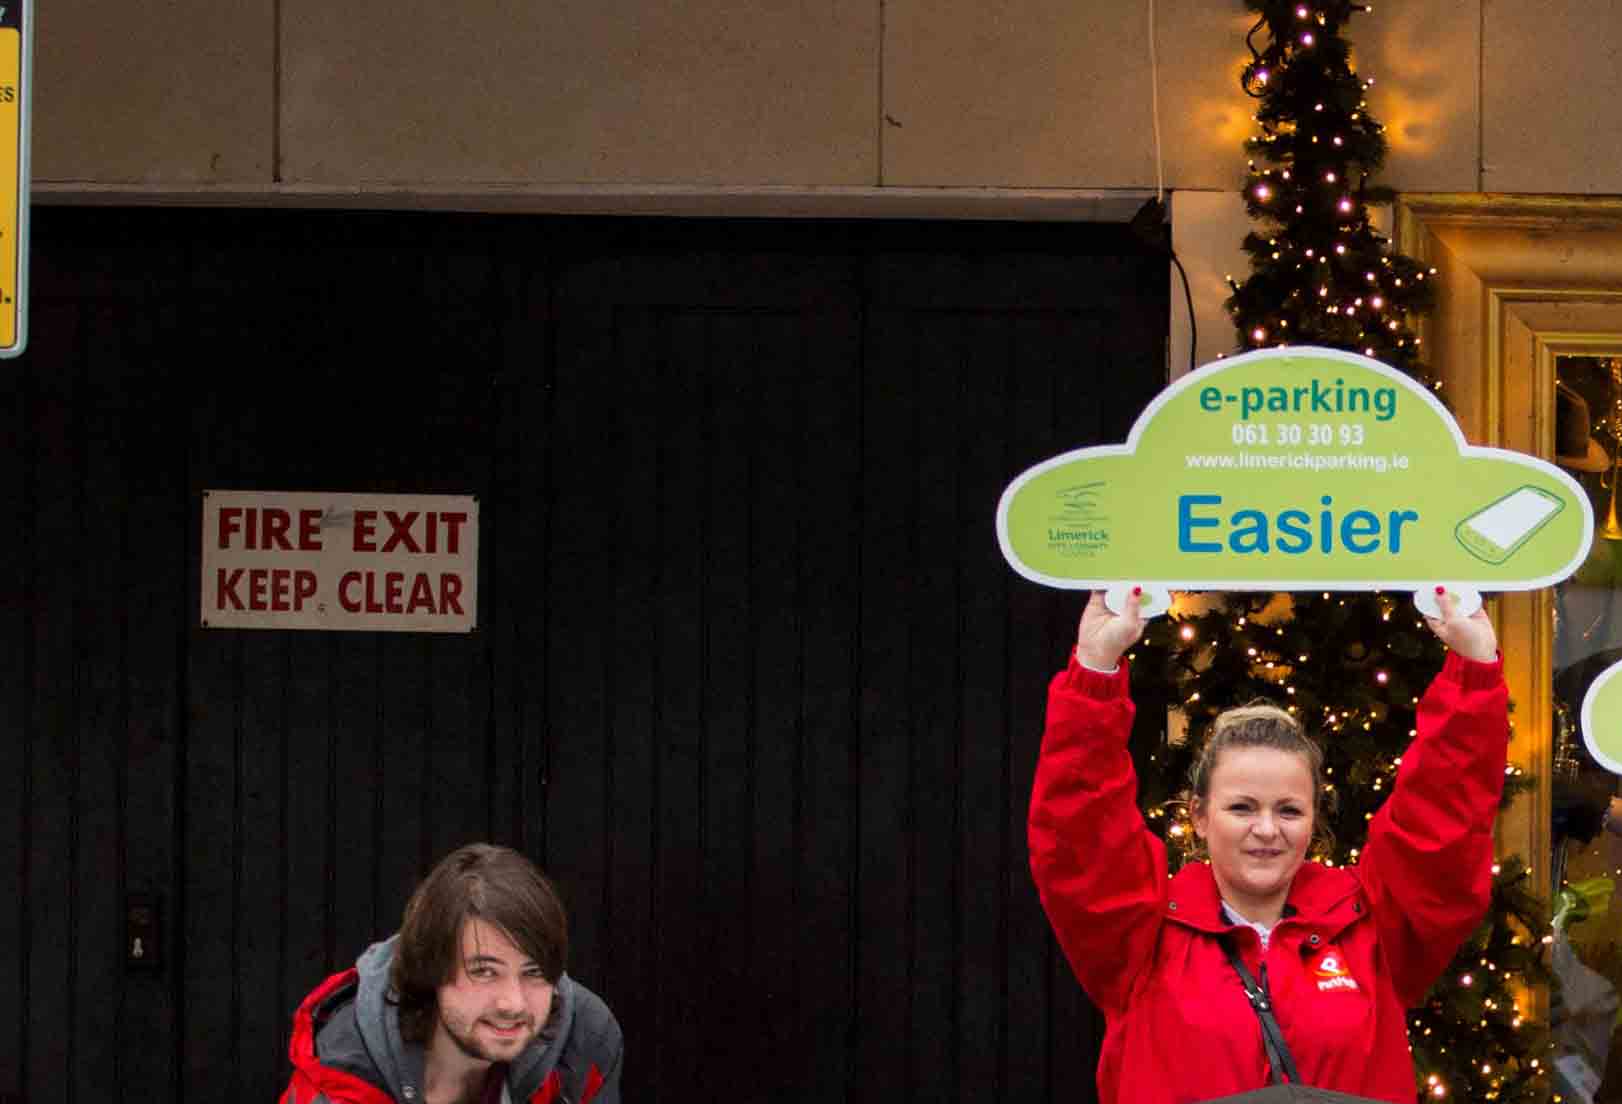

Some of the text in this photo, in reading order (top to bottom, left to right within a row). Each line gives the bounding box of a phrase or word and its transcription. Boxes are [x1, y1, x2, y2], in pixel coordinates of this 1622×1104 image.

[1200, 379, 1397, 420] e-parking
[1231, 424, 1364, 446] 061 30 30 93
[1186, 451, 1409, 473] www.limerickparking.ie
[218, 507, 467, 554] FIRE EXIT
[1178, 494, 1418, 554] Easier
[217, 568, 464, 615] KEEP CLEAR
